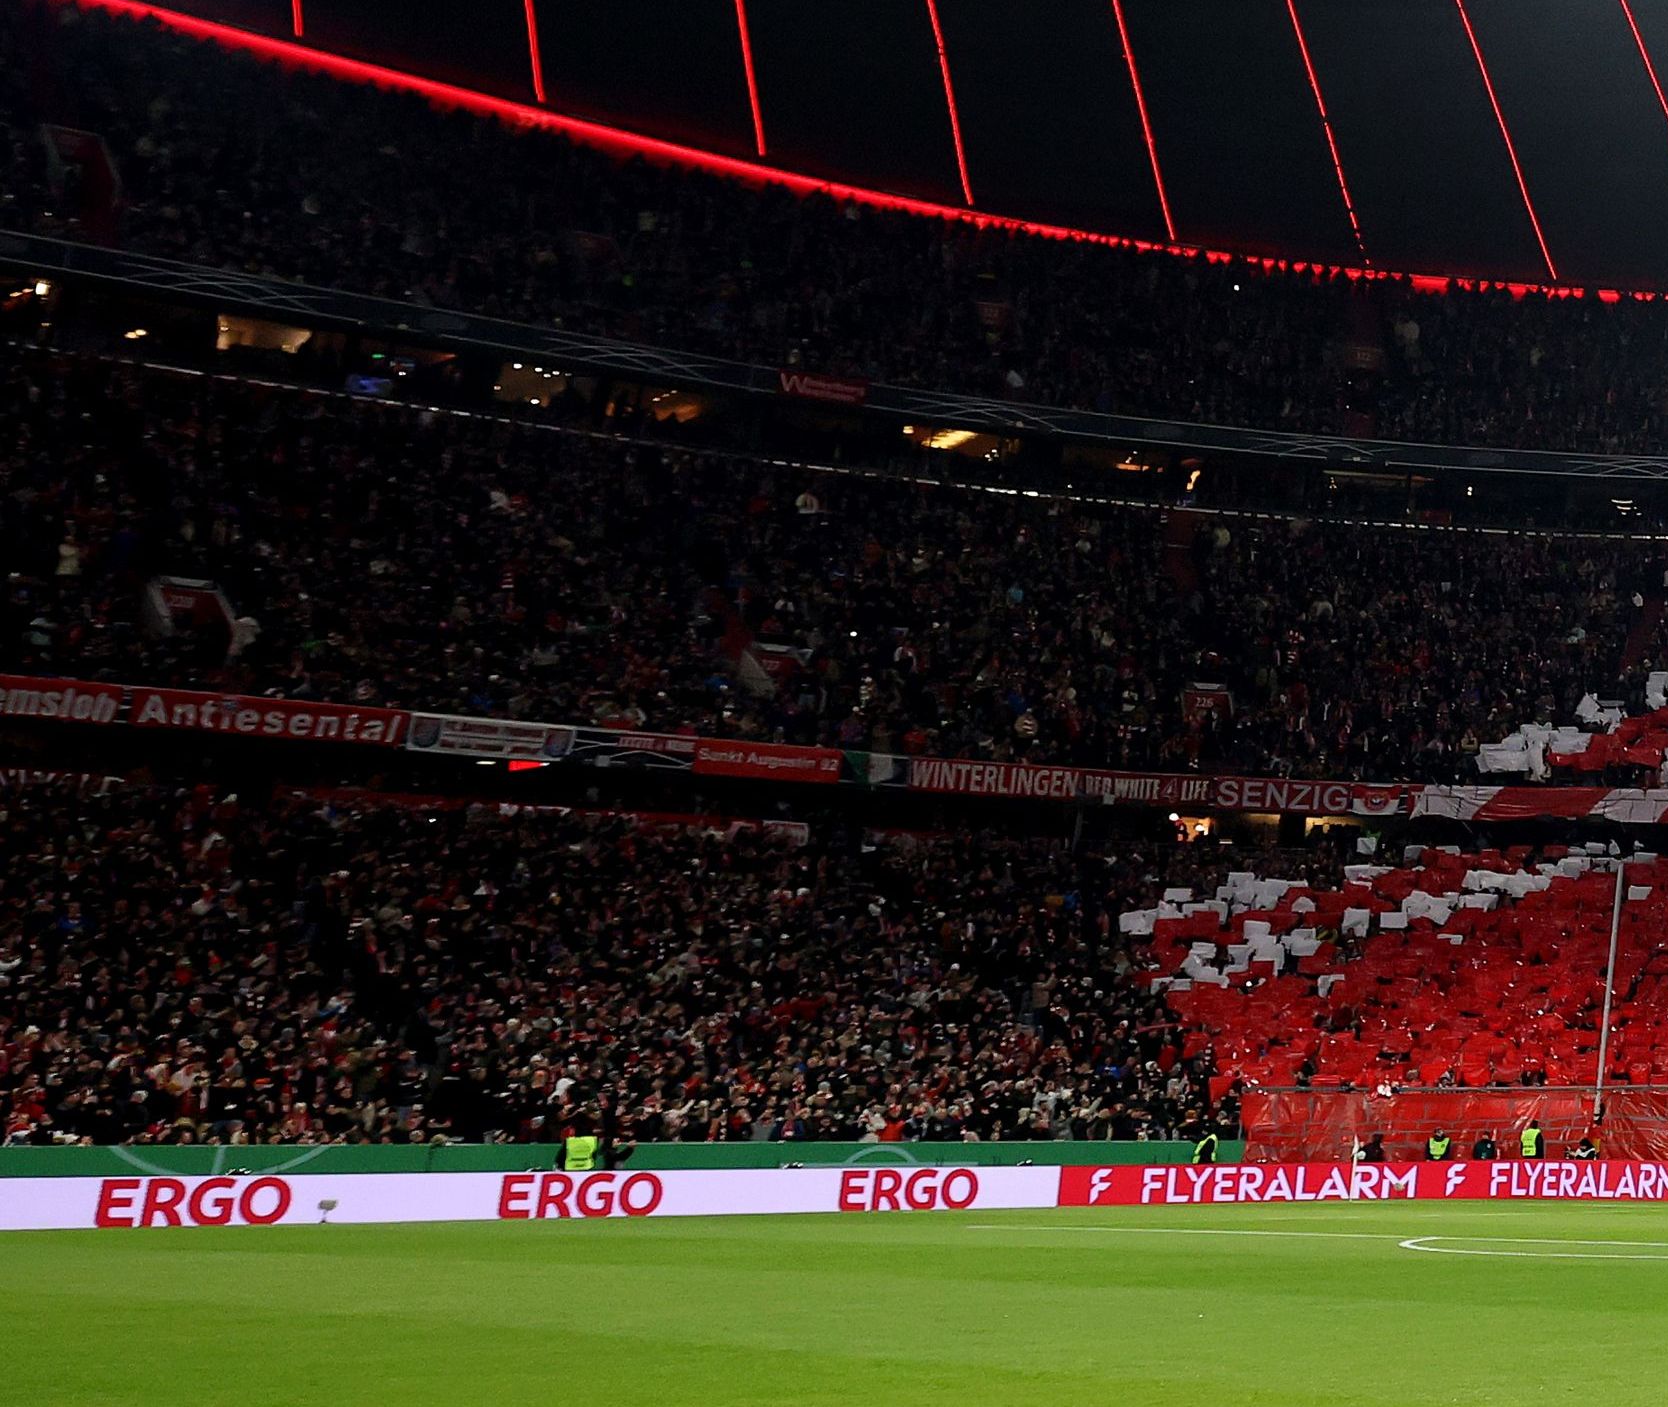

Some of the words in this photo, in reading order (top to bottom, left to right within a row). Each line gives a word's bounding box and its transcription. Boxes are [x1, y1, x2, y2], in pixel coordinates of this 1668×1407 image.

[137, 693, 402, 746] Antiesental
[911, 759, 1079, 797] WINTERLINGEN
[1114, 777, 1160, 801] WHITE
[1216, 780, 1349, 811] SENZIG
[95, 1178, 290, 1228] ERGO
[498, 1172, 663, 1220] ERGO
[840, 1168, 977, 1212] ERGO
[1141, 1165, 1419, 1203] FLYERALARM
